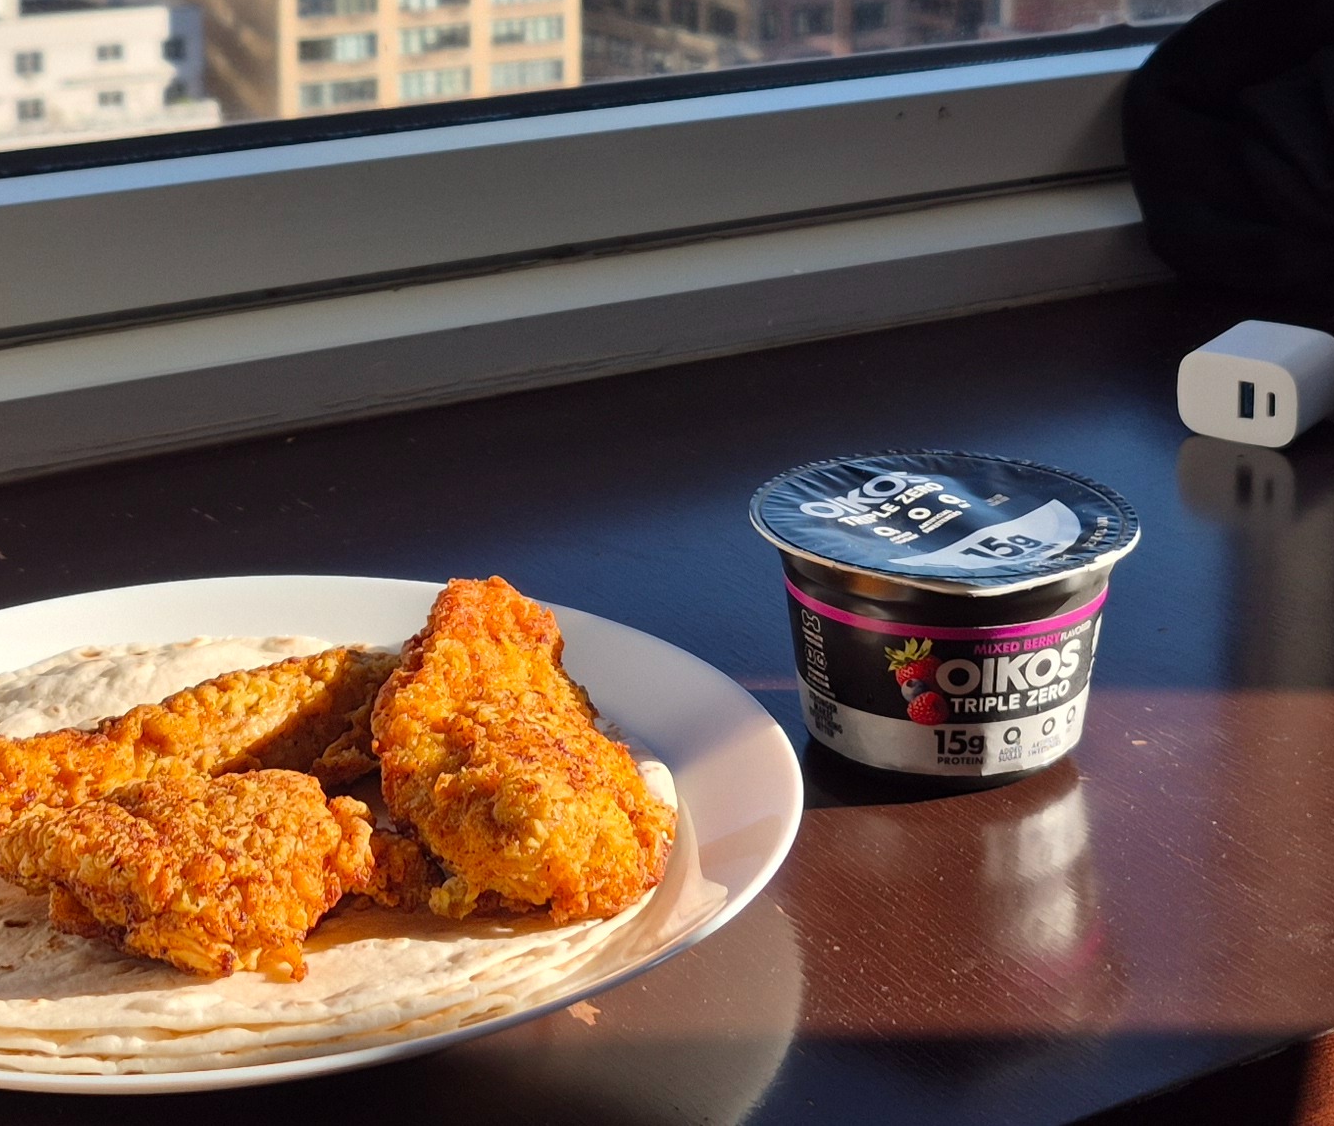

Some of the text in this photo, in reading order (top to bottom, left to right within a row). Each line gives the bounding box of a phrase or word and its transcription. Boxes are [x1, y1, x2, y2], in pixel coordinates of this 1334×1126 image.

[837, 501, 901, 527] TRIPLE
[893, 481, 944, 506] ZERO
[959, 534, 1043, 558] 15g
[973, 641, 1020, 656] MIXED
[1023, 631, 1062, 650] BERRY
[935, 638, 1082, 695] OIKOS
[950, 679, 1071, 714] TRIPLE ZERO
[933, 729, 987, 756] 15g
[998, 745, 1023, 756] ADDED
[937, 756, 984, 766] PROTEIN
